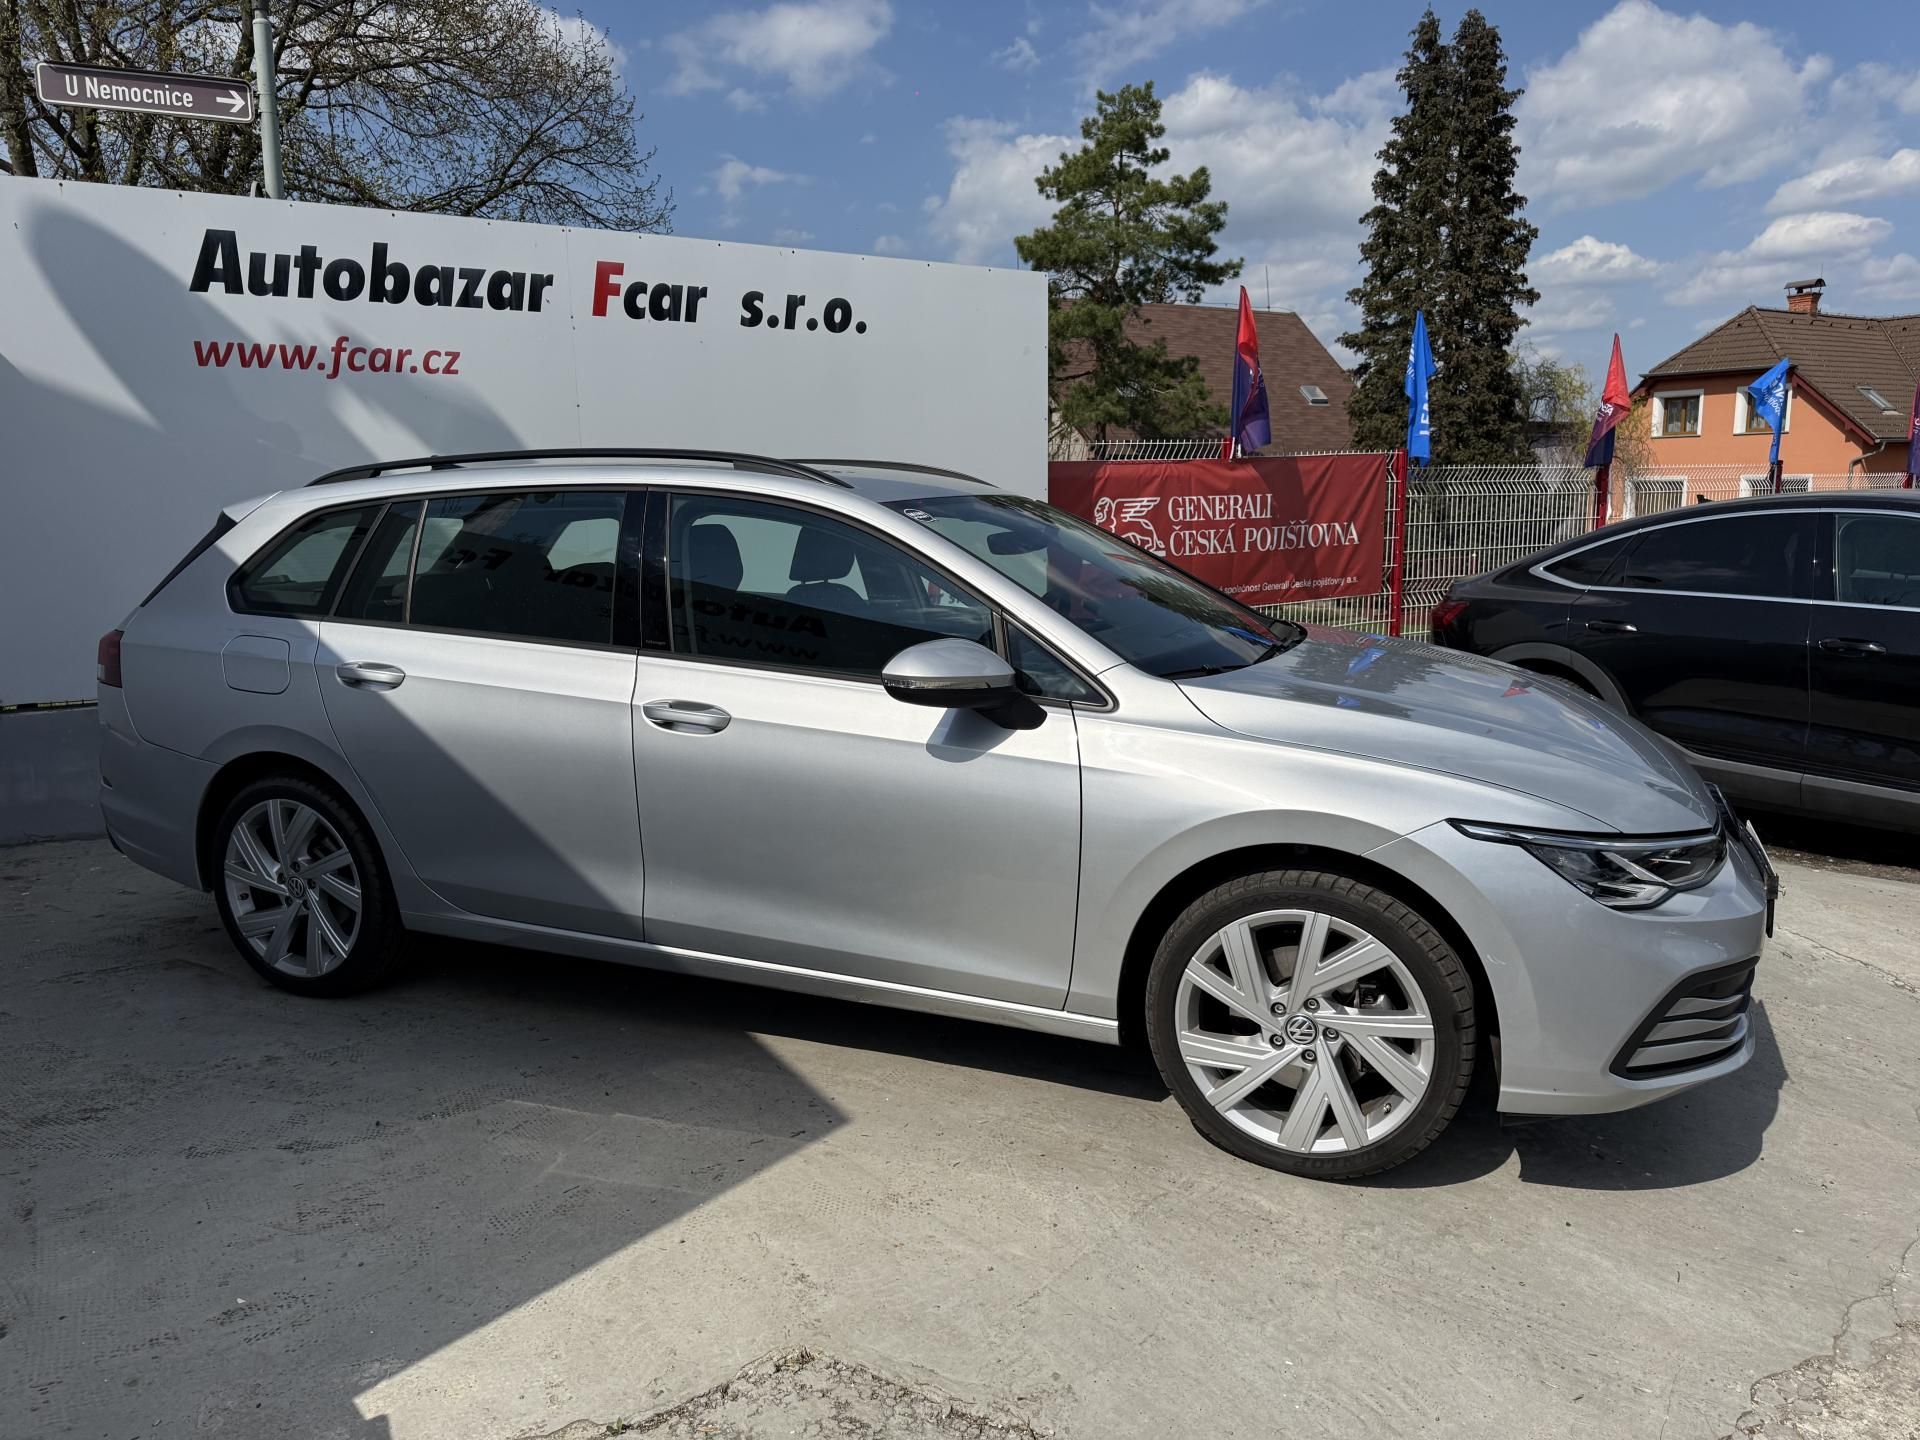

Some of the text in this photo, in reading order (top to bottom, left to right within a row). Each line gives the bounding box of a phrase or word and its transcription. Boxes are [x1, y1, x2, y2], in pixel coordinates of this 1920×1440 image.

[65, 75, 194, 108] U Nemocnice
[188, 228, 867, 335] Autobazar Fcar s.r.o.
[194, 336, 461, 379] www.fcar.cz
[1167, 493, 1274, 522] GENERALI
[1169, 520, 1360, 557] ČESKÁ POJIŠŤOVNA
[1262, 580, 1290, 591] Generali
